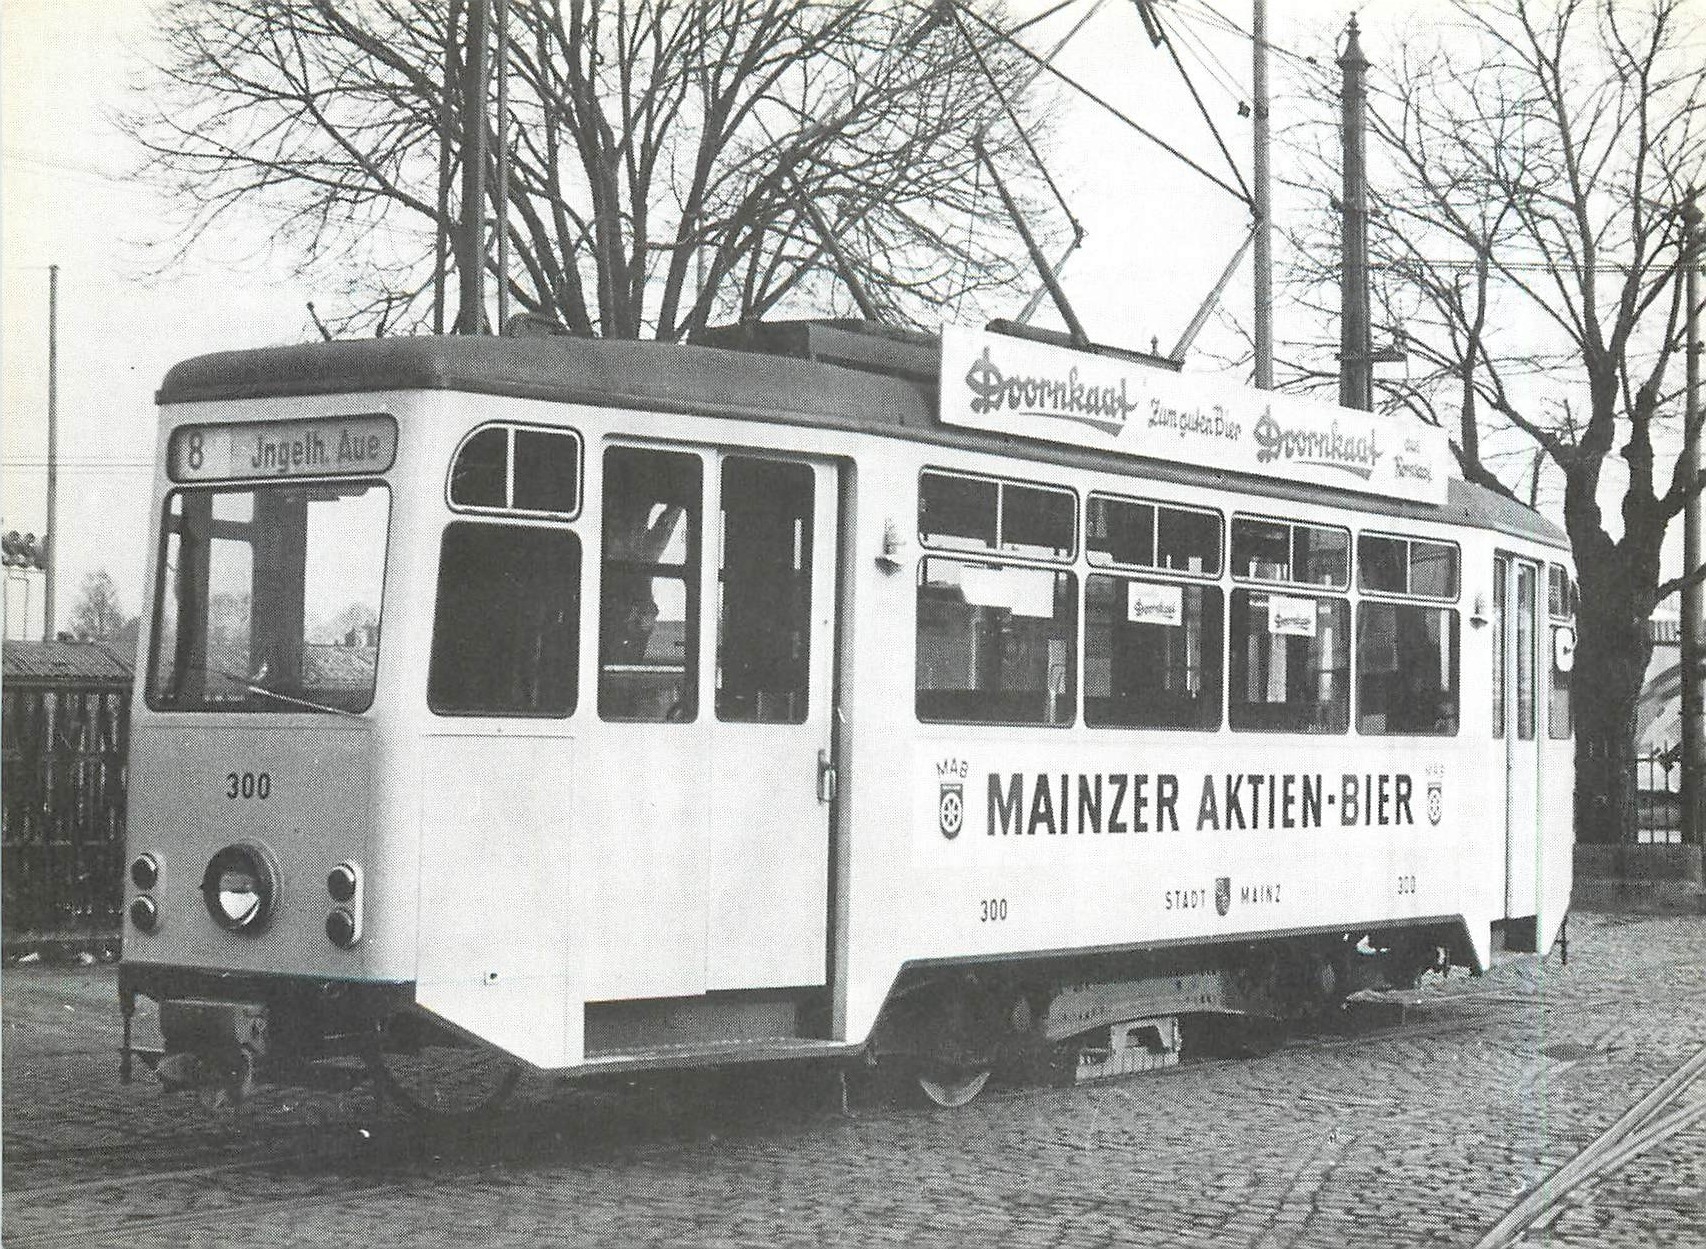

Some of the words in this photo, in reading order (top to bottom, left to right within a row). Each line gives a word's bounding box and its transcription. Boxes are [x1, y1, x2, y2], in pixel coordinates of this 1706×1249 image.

[965, 345, 1139, 421] Doornkaat
[188, 433, 204, 470] 8
[337, 428, 381, 463] Aue
[1253, 404, 1383, 466] Doornkaat
[226, 772, 271, 799] 300
[987, 772, 1180, 836] MAINZER
[980, 898, 1008, 922] 300
[1165, 889, 1206, 910] STADT
[1240, 883, 1281, 904] MAINZ
